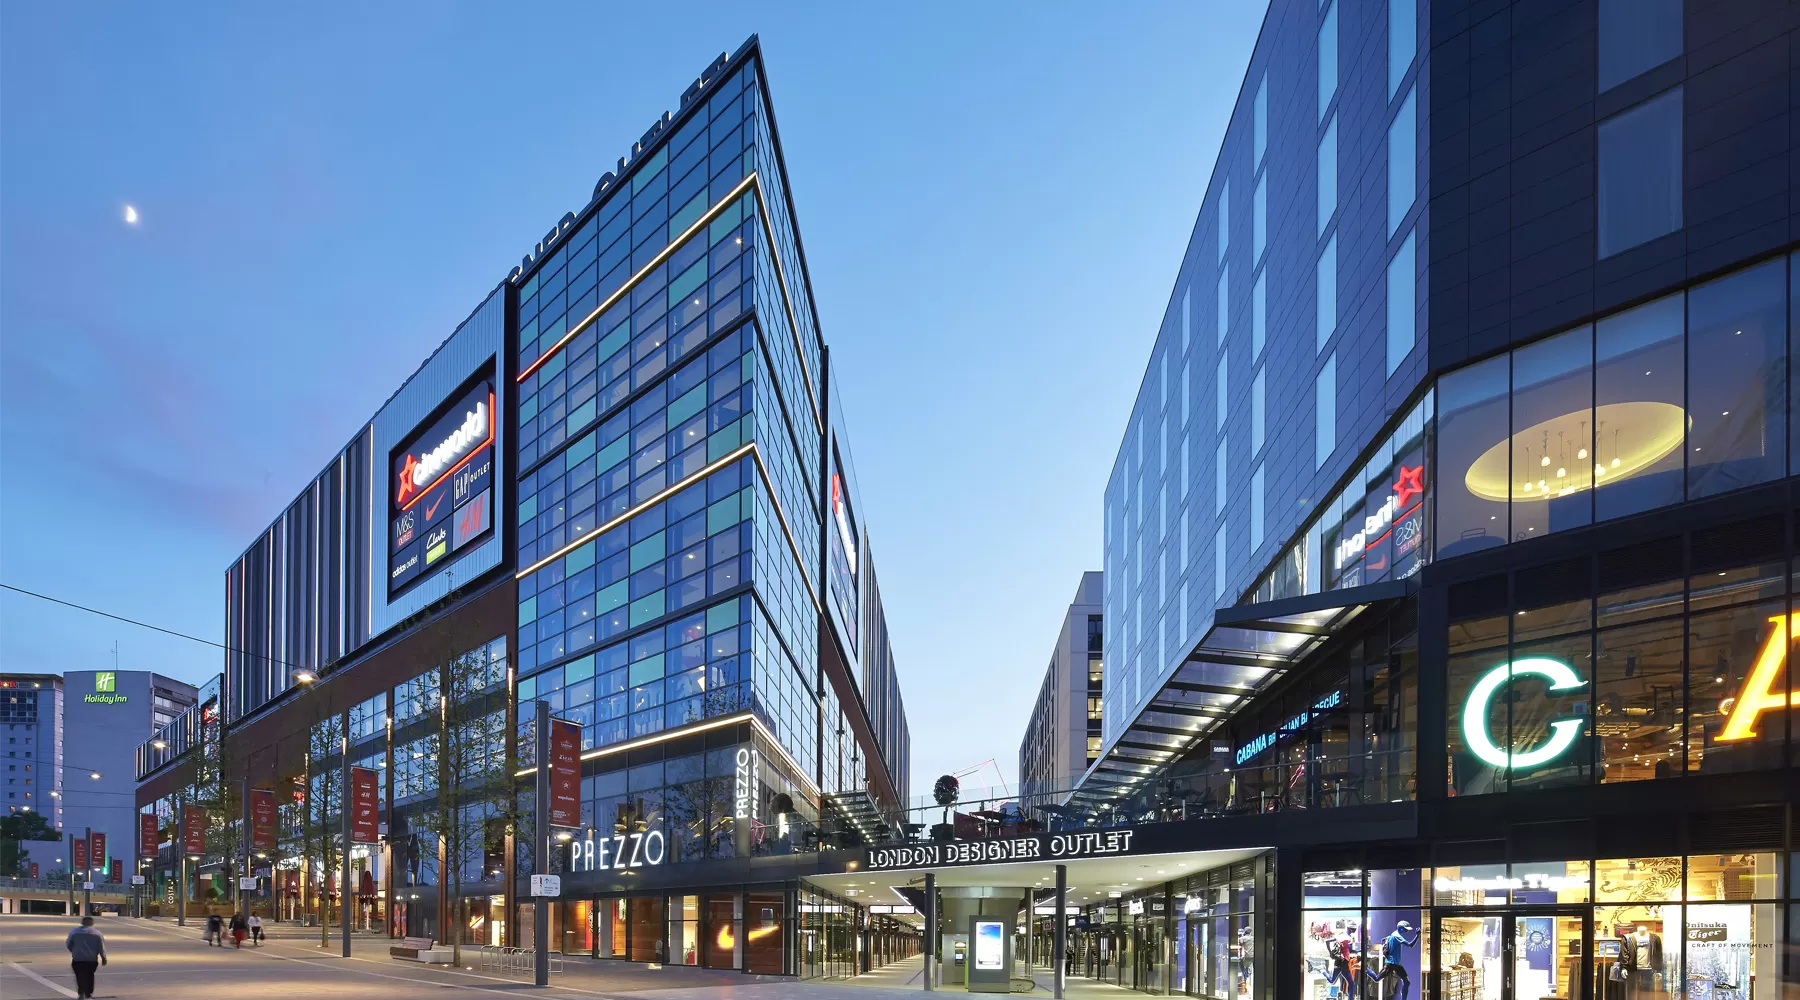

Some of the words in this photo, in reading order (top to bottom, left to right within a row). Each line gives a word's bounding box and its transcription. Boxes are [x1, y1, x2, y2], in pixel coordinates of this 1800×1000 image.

[455, 472, 468, 500] GAP
[469, 461, 490, 483] OUTLET
[396, 510, 415, 538] M&S
[459, 494, 483, 542] H&M
[398, 530, 412, 546] OUTLET
[426, 528, 447, 550] Clarks
[392, 564, 406, 578] adidas
[84, 694, 114, 705] Holiday
[114, 694, 128, 703] Inn
[1463, 658, 1590, 768] C
[1237, 733, 1267, 765] CABANA
[736, 748, 749, 819] PREZZO
[751, 749, 759, 820] PREZZO
[572, 830, 664, 872] PREZZO
[868, 845, 939, 868] LONDON
[945, 838, 1040, 863] DESIGNER
[1050, 830, 1133, 856] OUTLET
[1688, 929, 1722, 939] Tiger
